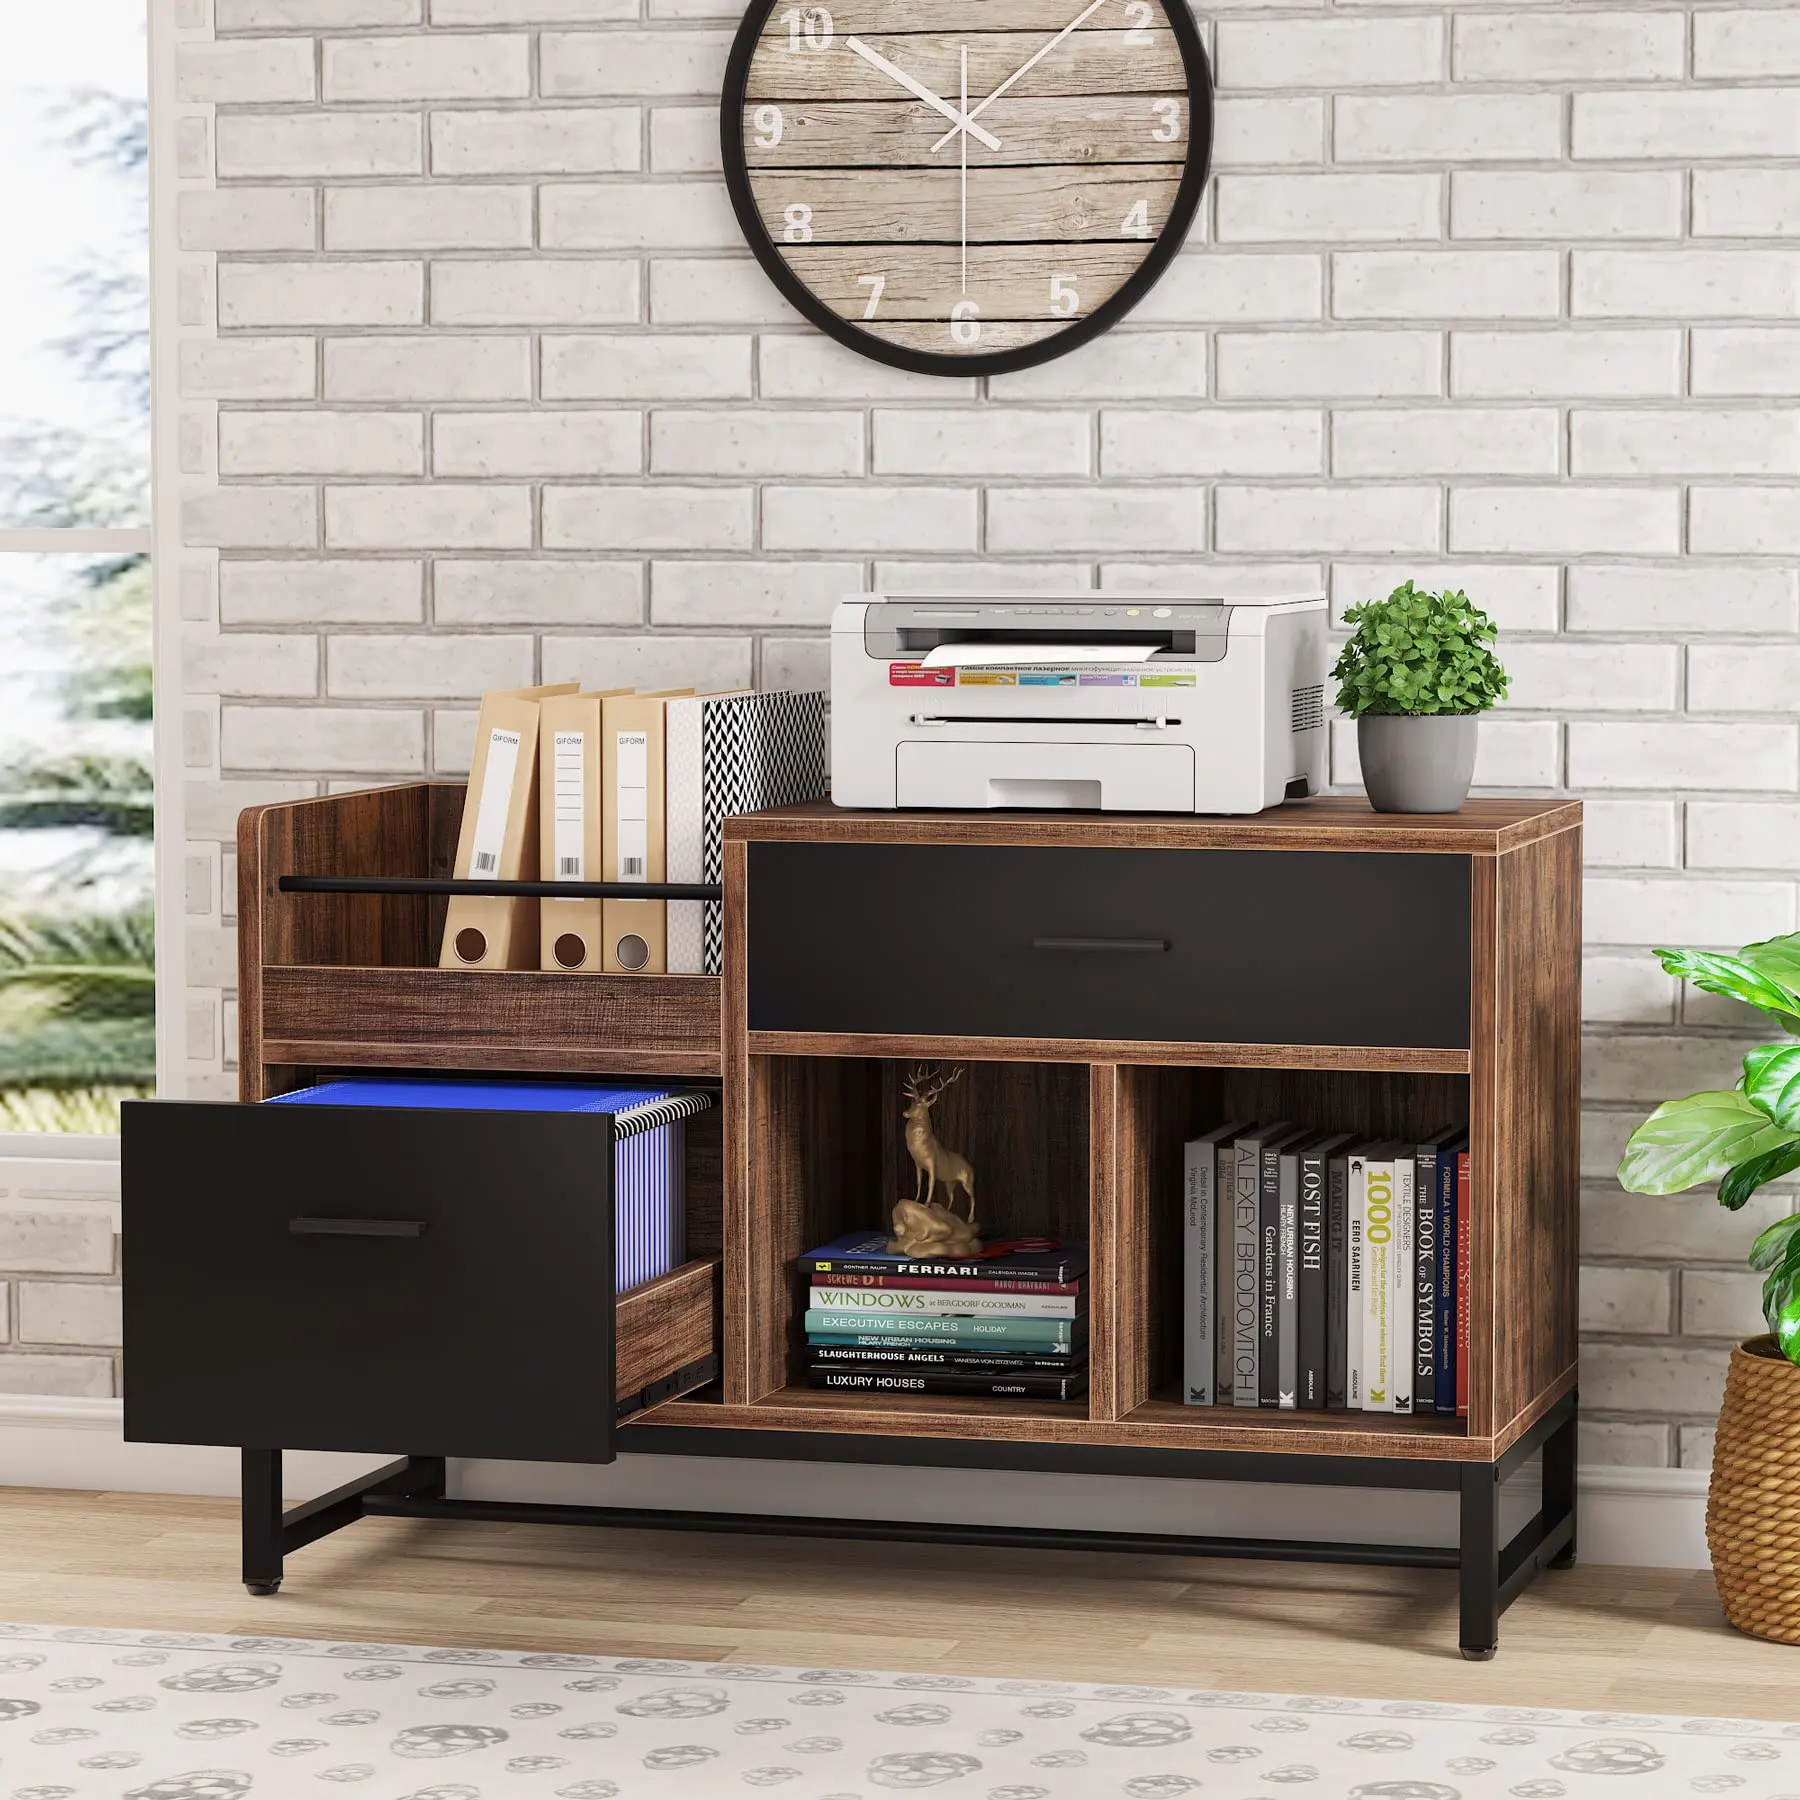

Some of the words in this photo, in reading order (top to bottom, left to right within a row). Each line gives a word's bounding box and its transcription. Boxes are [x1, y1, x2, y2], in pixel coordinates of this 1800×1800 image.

[780, 7, 834, 53] 10
[1124, 1, 1154, 45] 2
[753, 105, 783, 148] 9
[1151, 98, 1181, 142] 3
[783, 203, 813, 243] 8
[1121, 200, 1153, 238] 4
[857, 276, 885, 319] 7
[1050, 276, 1080, 318] 5
[950, 301, 981, 344] 6
[492, 734, 518, 745] GIFORM
[1189, 1167, 1198, 1194] Virginia
[1200, 1166, 1209, 1188] Detail
[1236, 1147, 1256, 1235] ALEXEY
[1303, 1158, 1321, 1216] LOST
[1403, 1173, 1411, 1205] TEXTILE
[1419, 1185, 1427, 1204] THE
[1443, 1166, 1451, 1207] FORMULA
[1199, 1198, 1208, 1251] Contemporary
[1286, 1204, 1294, 1224] NEW
[1367, 1171, 1391, 1244] 1000
[1286, 1226, 1294, 1257] URBAN
[1303, 1220, 1321, 1271] FISH
[1352, 1220, 1361, 1242] EERO
[1402, 1206, 1411, 1251] DESIGNERS
[1418, 1208, 1434, 1261] BOOK
[1443, 1215, 1451, 1246] WORLD
[897, 1264, 978, 1276] FERRARI
[1265, 1225, 1277, 1277] Gardens
[1351, 1246, 1361, 1291] SAARINEN
[1200, 1253, 1208, 1294] Residential
[1265, 1280, 1276, 1292] in
[1286, 1259, 1294, 1299] HOUSING
[1419, 1265, 1427, 1279] OF
[1442, 1247, 1451, 1297] CHAMPIONS
[818, 1291, 925, 1309] WINDOWS
[937, 1299, 980, 1309] BERGDORF
[981, 1300, 1026, 1310] GOODMAN
[1200, 1295, 1208, 1340] Architecture
[1236, 1242, 1256, 1389] BRODOVITCH
[1265, 1294, 1276, 1337] France
[823, 1317, 894, 1329] EXECUTIVE
[898, 1320, 959, 1332] ESCAPES
[914, 1337, 956, 1345] HOUSING
[973, 1325, 1007, 1333] HOLIDAY
[1418, 1282, 1434, 1376] SYMBOLS
[818, 1350, 905, 1361] SLAUGHTERHOUSE
[908, 1353, 945, 1362] ANGELS
[826, 1375, 873, 1387] LUXURY
[876, 1377, 925, 1389] HOUSES
[992, 1385, 1026, 1393] COUNTRY
